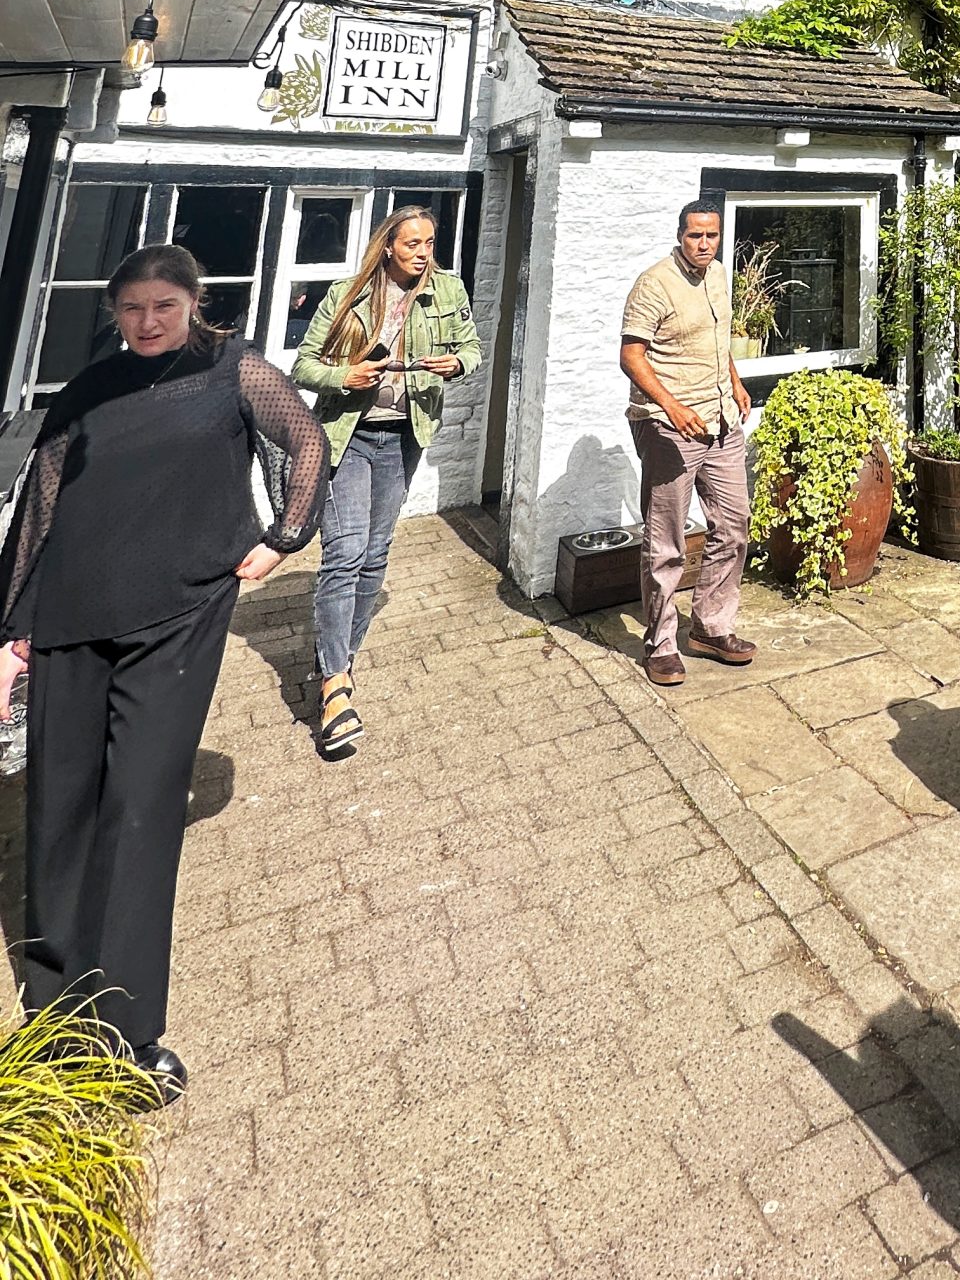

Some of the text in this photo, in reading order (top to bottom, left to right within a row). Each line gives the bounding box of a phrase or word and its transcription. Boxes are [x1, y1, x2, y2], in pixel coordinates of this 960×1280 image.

[345, 29, 436, 56] SHIBDEN
[341, 57, 432, 82] MILL
[338, 84, 430, 109] INN
